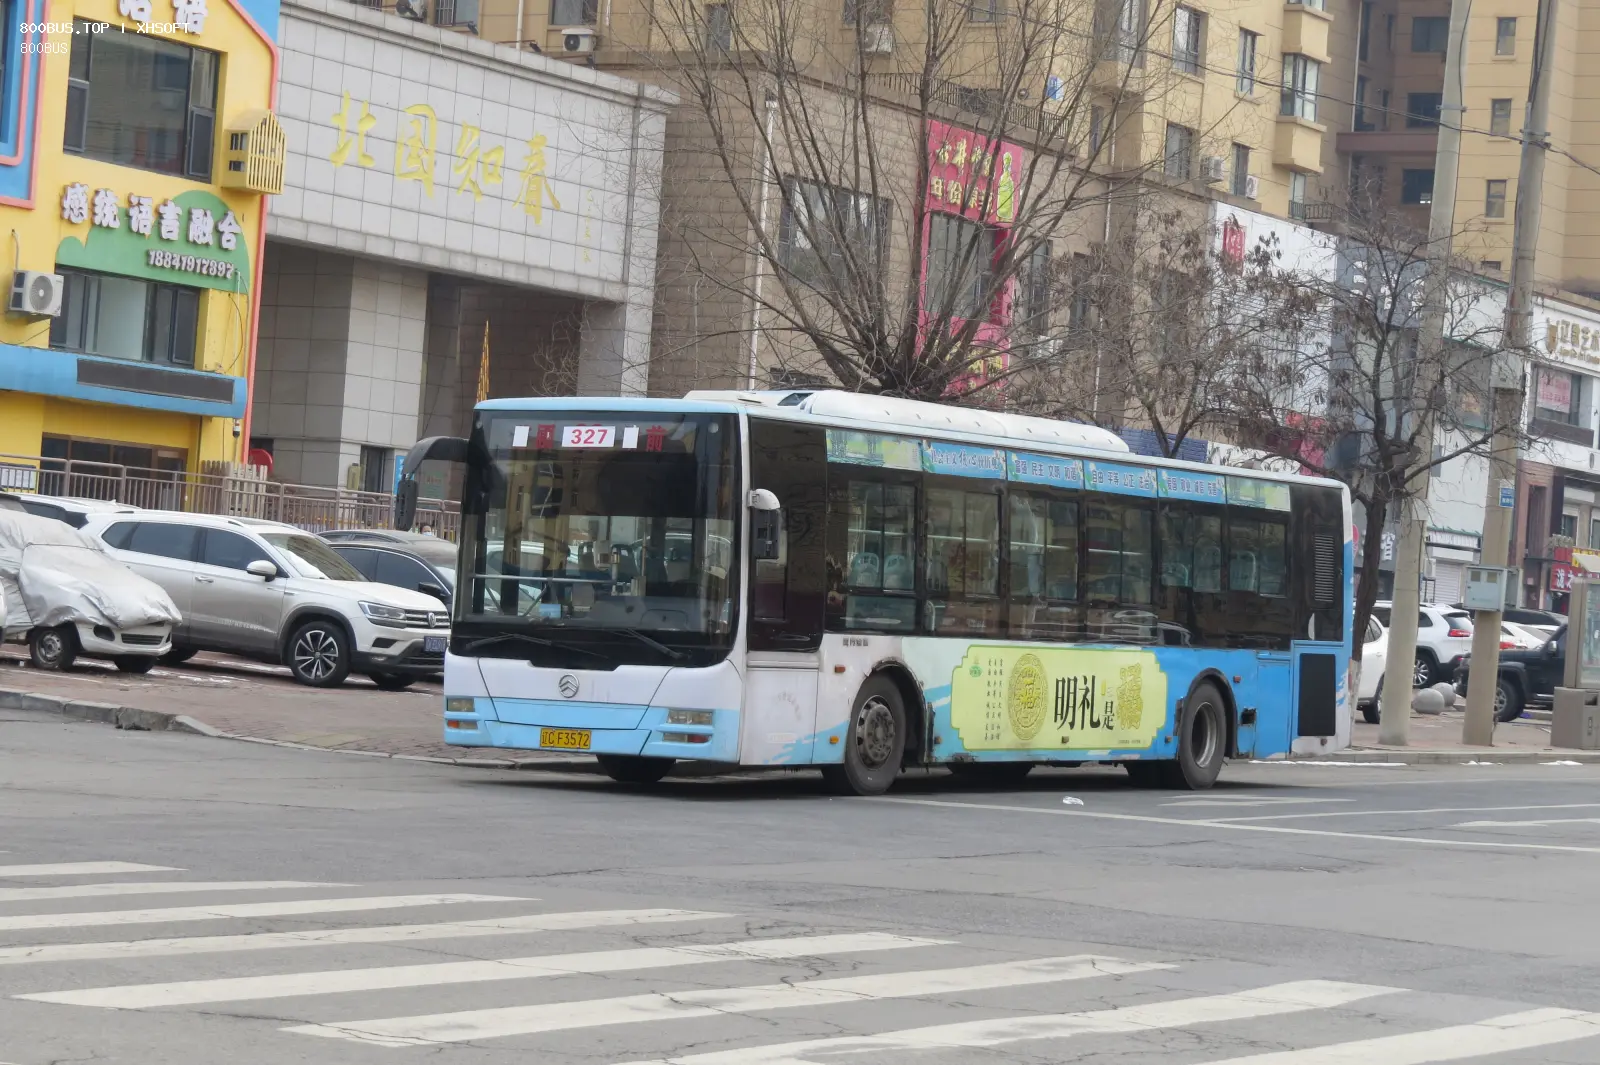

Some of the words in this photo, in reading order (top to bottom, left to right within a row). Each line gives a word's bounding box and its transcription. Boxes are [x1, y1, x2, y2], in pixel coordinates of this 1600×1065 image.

[62, 181, 242, 251] 感统语言融合
[571, 428, 608, 445] 327
